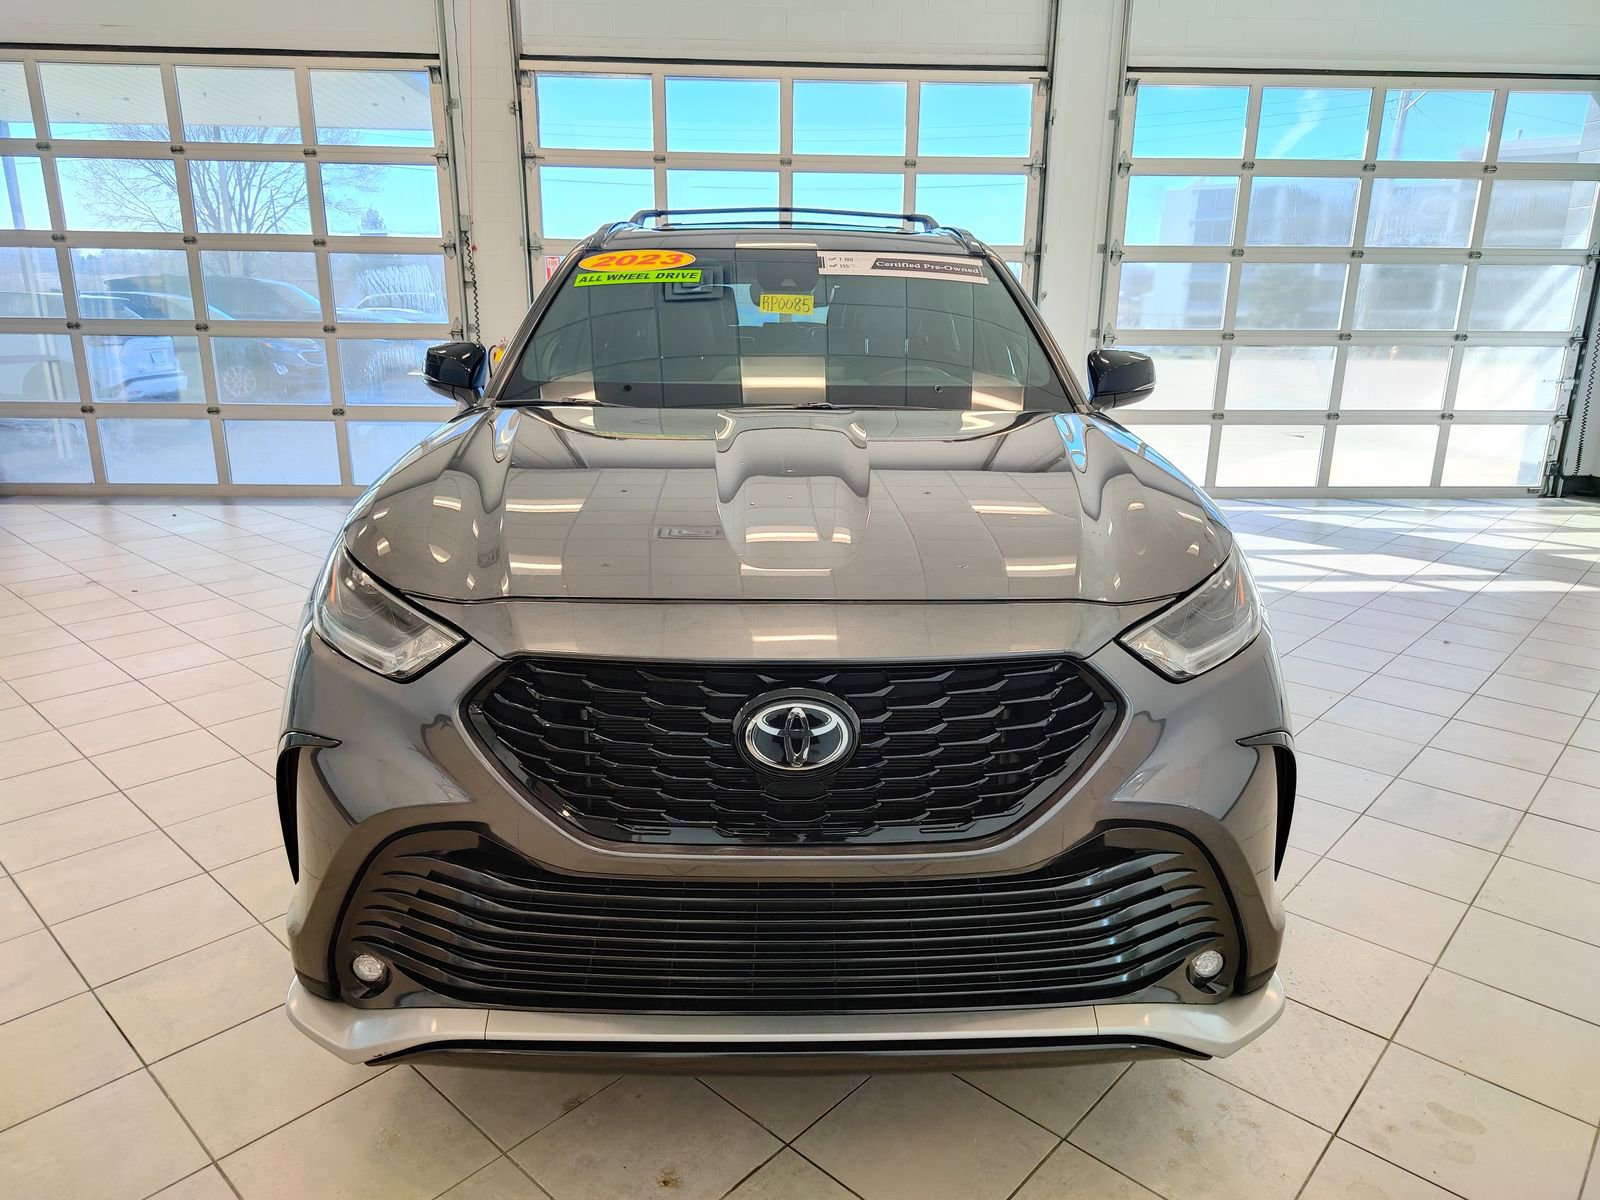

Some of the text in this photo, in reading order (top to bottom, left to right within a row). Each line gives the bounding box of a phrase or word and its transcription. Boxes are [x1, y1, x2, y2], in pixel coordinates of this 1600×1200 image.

[591, 254, 684, 267] 2023
[875, 261, 980, 274] Certified Pre-Owned
[579, 271, 698, 283] ALL WHEEL DRIVE
[762, 295, 811, 313] RP0085
